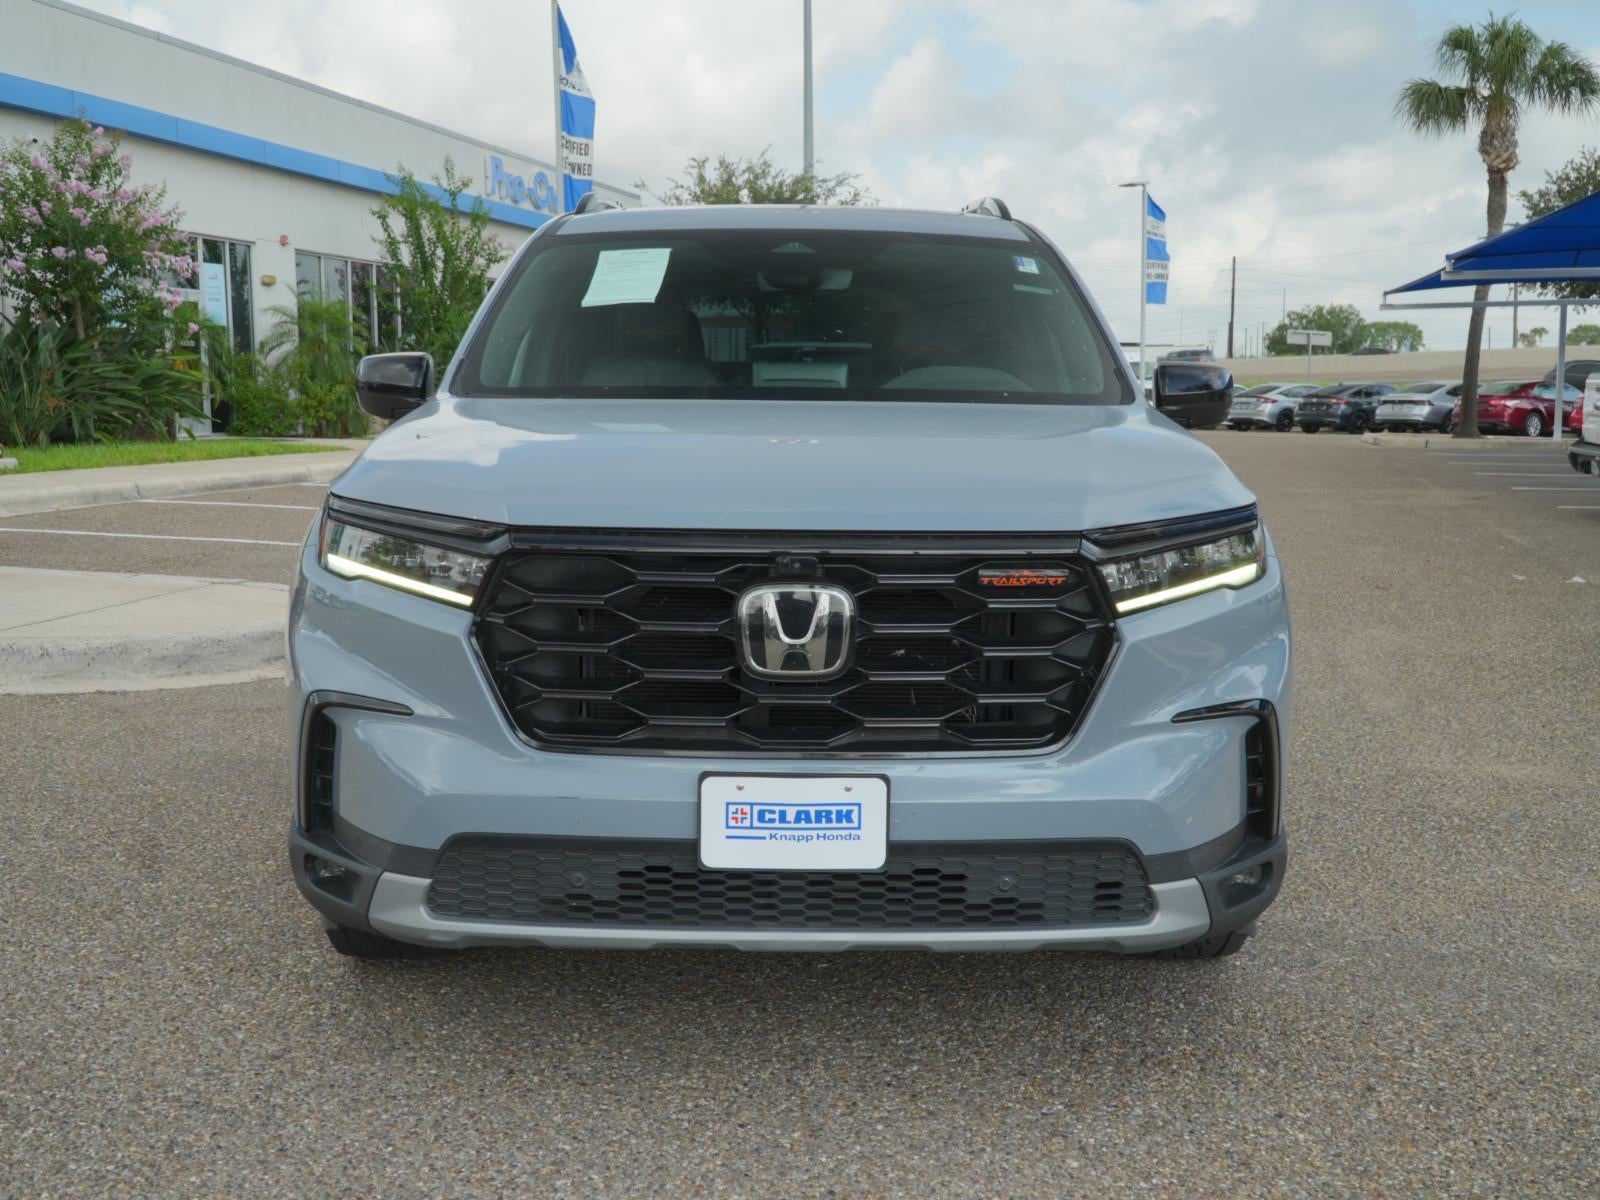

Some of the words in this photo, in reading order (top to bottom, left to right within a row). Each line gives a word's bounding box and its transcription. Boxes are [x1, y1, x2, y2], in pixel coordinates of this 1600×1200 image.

[981, 576, 1067, 586] TRAILSPORT
[757, 808, 855, 825] CLARK
[769, 832, 814, 843] Knapp
[816, 832, 861, 842] Honda
